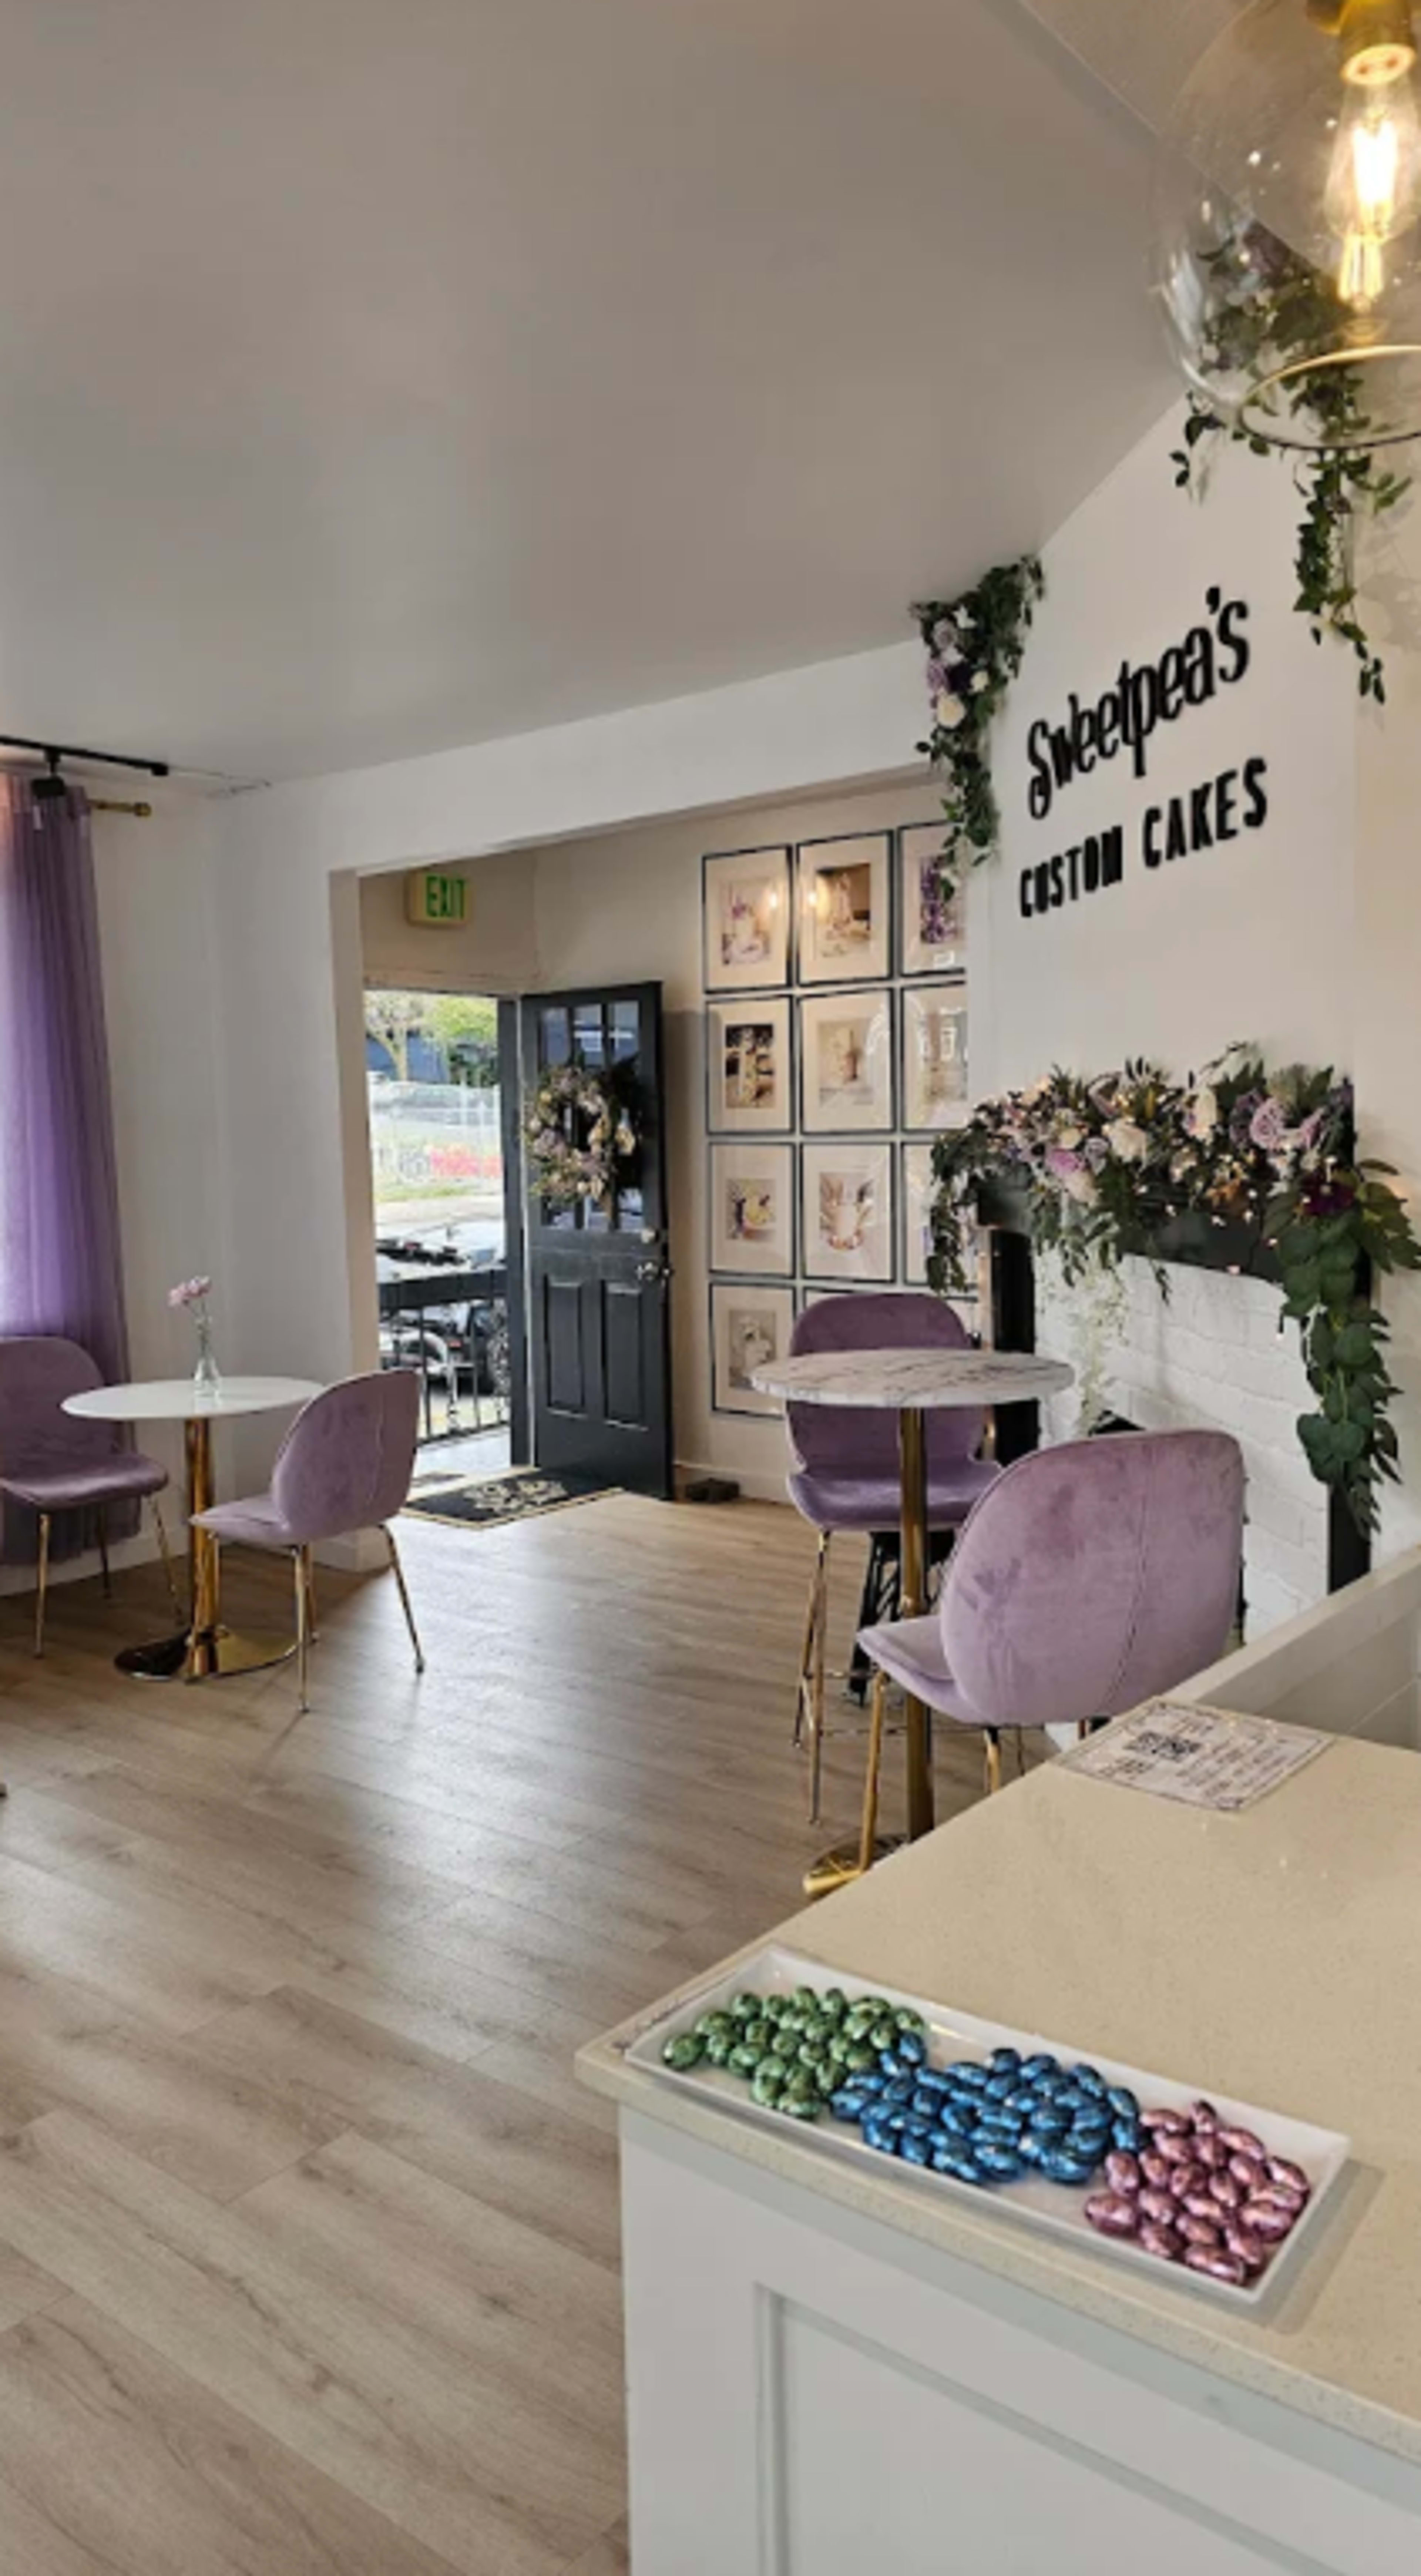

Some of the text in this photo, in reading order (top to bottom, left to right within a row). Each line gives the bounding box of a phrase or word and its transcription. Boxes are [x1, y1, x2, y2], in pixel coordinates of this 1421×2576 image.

[1028, 586, 1249, 820] Sweetpea's
[426, 875, 466, 921] EXIT
[1020, 757, 1267, 917] CUSTOM CAKES
